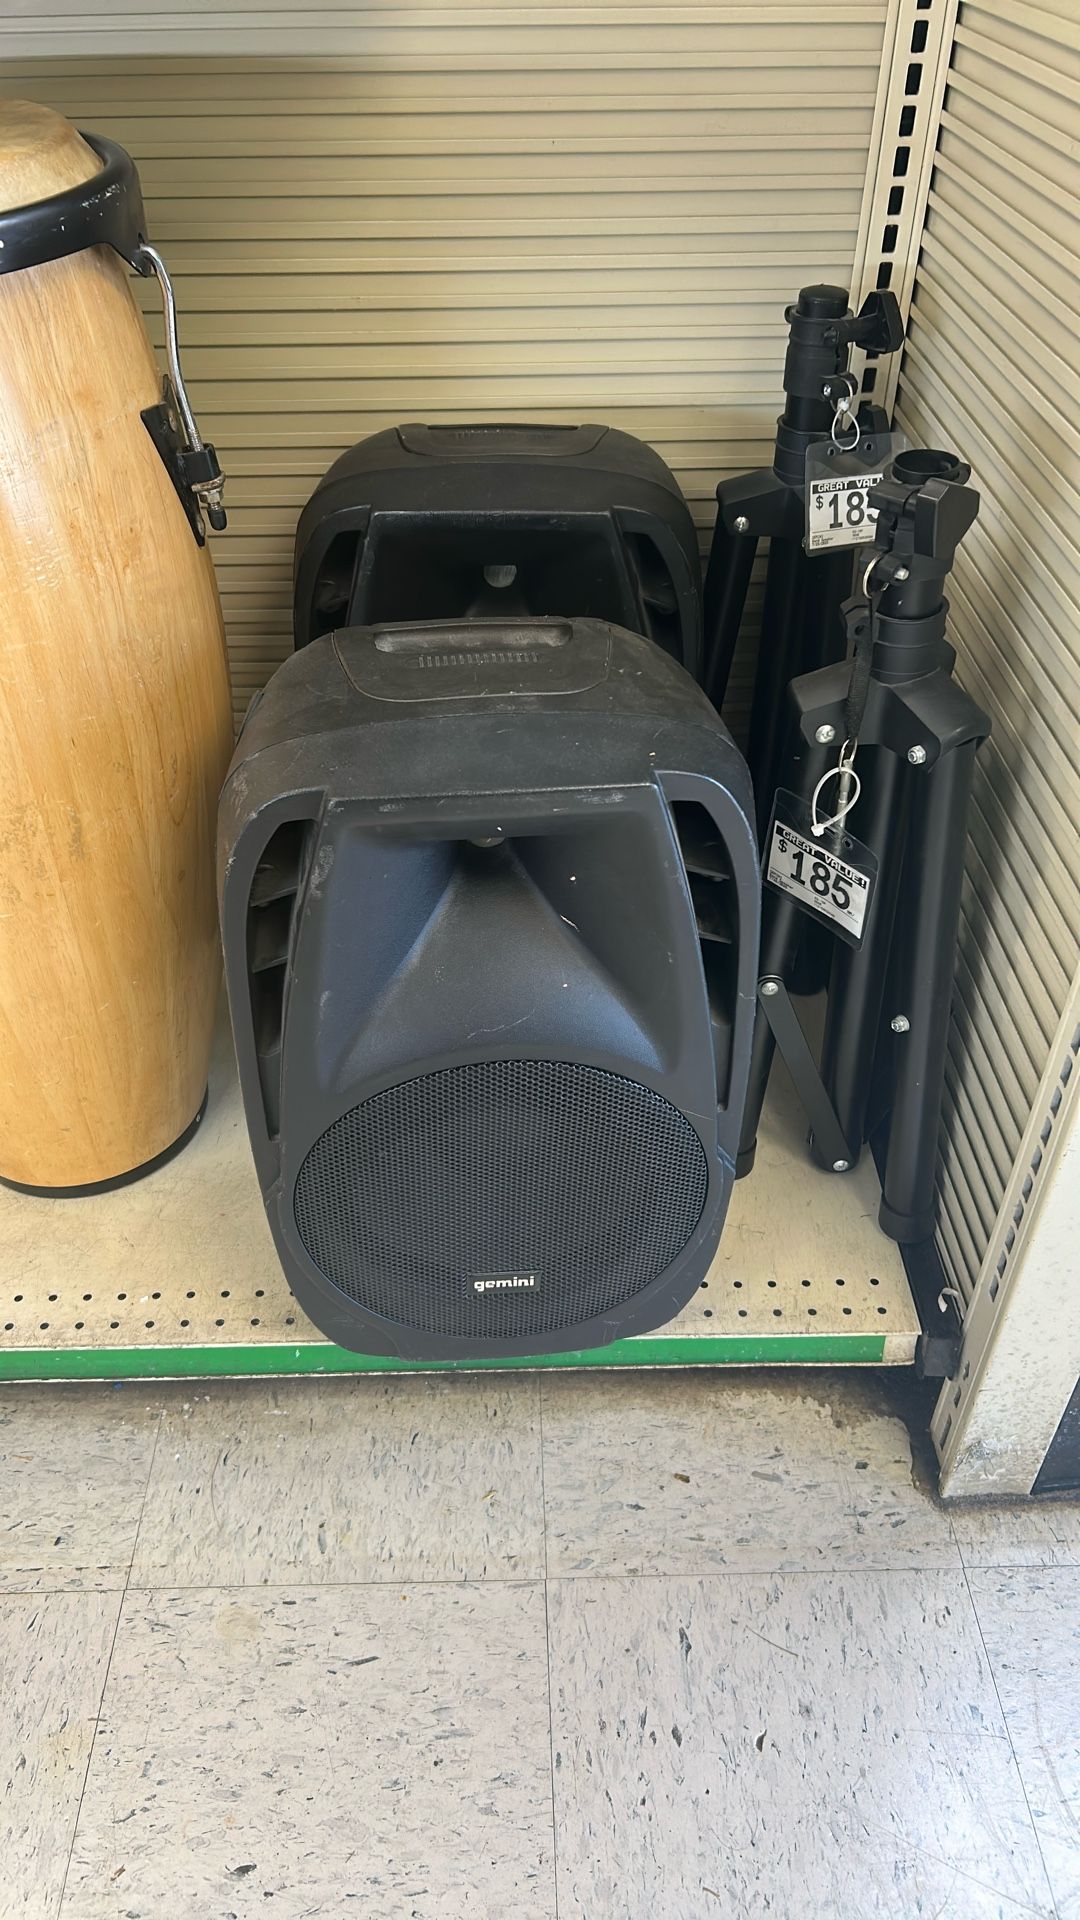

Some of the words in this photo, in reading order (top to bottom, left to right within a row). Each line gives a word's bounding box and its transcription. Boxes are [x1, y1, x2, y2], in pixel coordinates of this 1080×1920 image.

[818, 481, 849, 492] GREAT
[782, 830, 816, 856] GREAT
[825, 855, 866, 888] VALUE!
[474, 1276, 535, 1292] gemini
